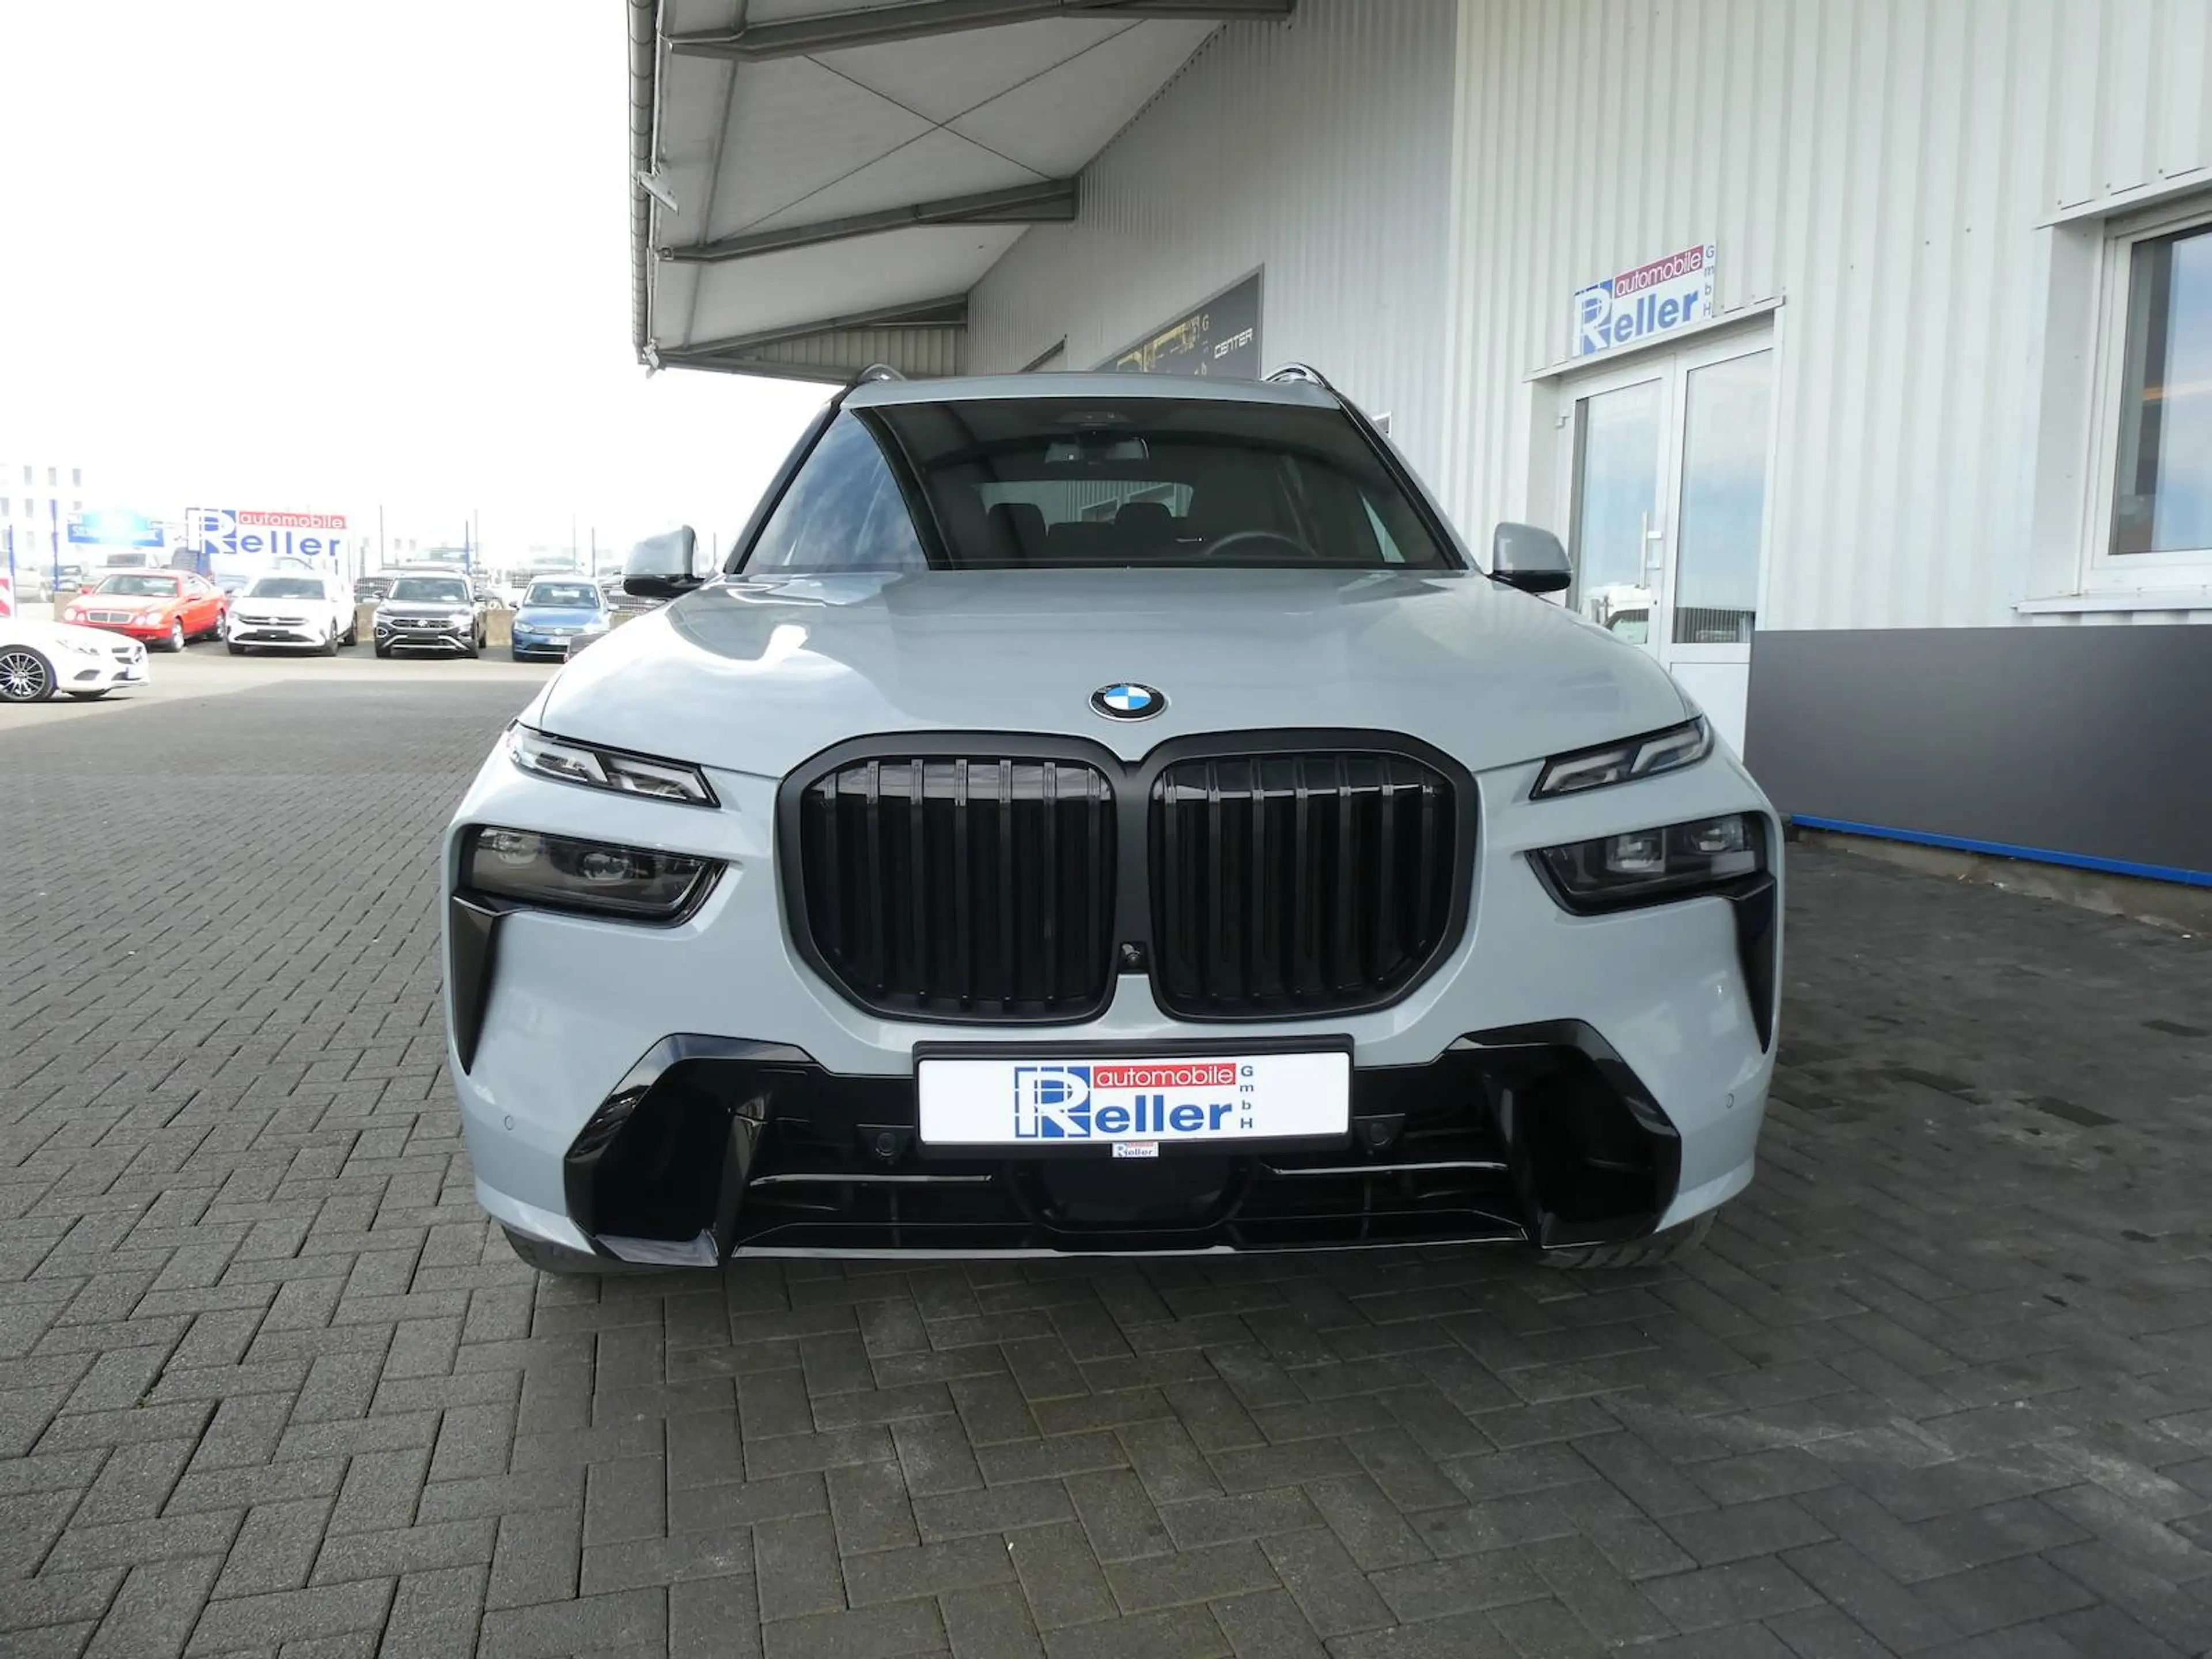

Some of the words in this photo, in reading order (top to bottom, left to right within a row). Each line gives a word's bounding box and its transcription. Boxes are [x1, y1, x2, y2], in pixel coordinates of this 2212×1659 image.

[1615, 251, 1702, 296] automobile
[1703, 245, 1715, 316] GmbH
[1214, 327, 1253, 359] CENTER
[1573, 285, 1699, 358] Reller
[186, 508, 341, 555] Reller
[240, 512, 344, 528] automobile
[1096, 1065, 1234, 1086] automobile
[1239, 1065, 1254, 1129] GmbH
[1016, 1069, 1232, 1137] Reller
